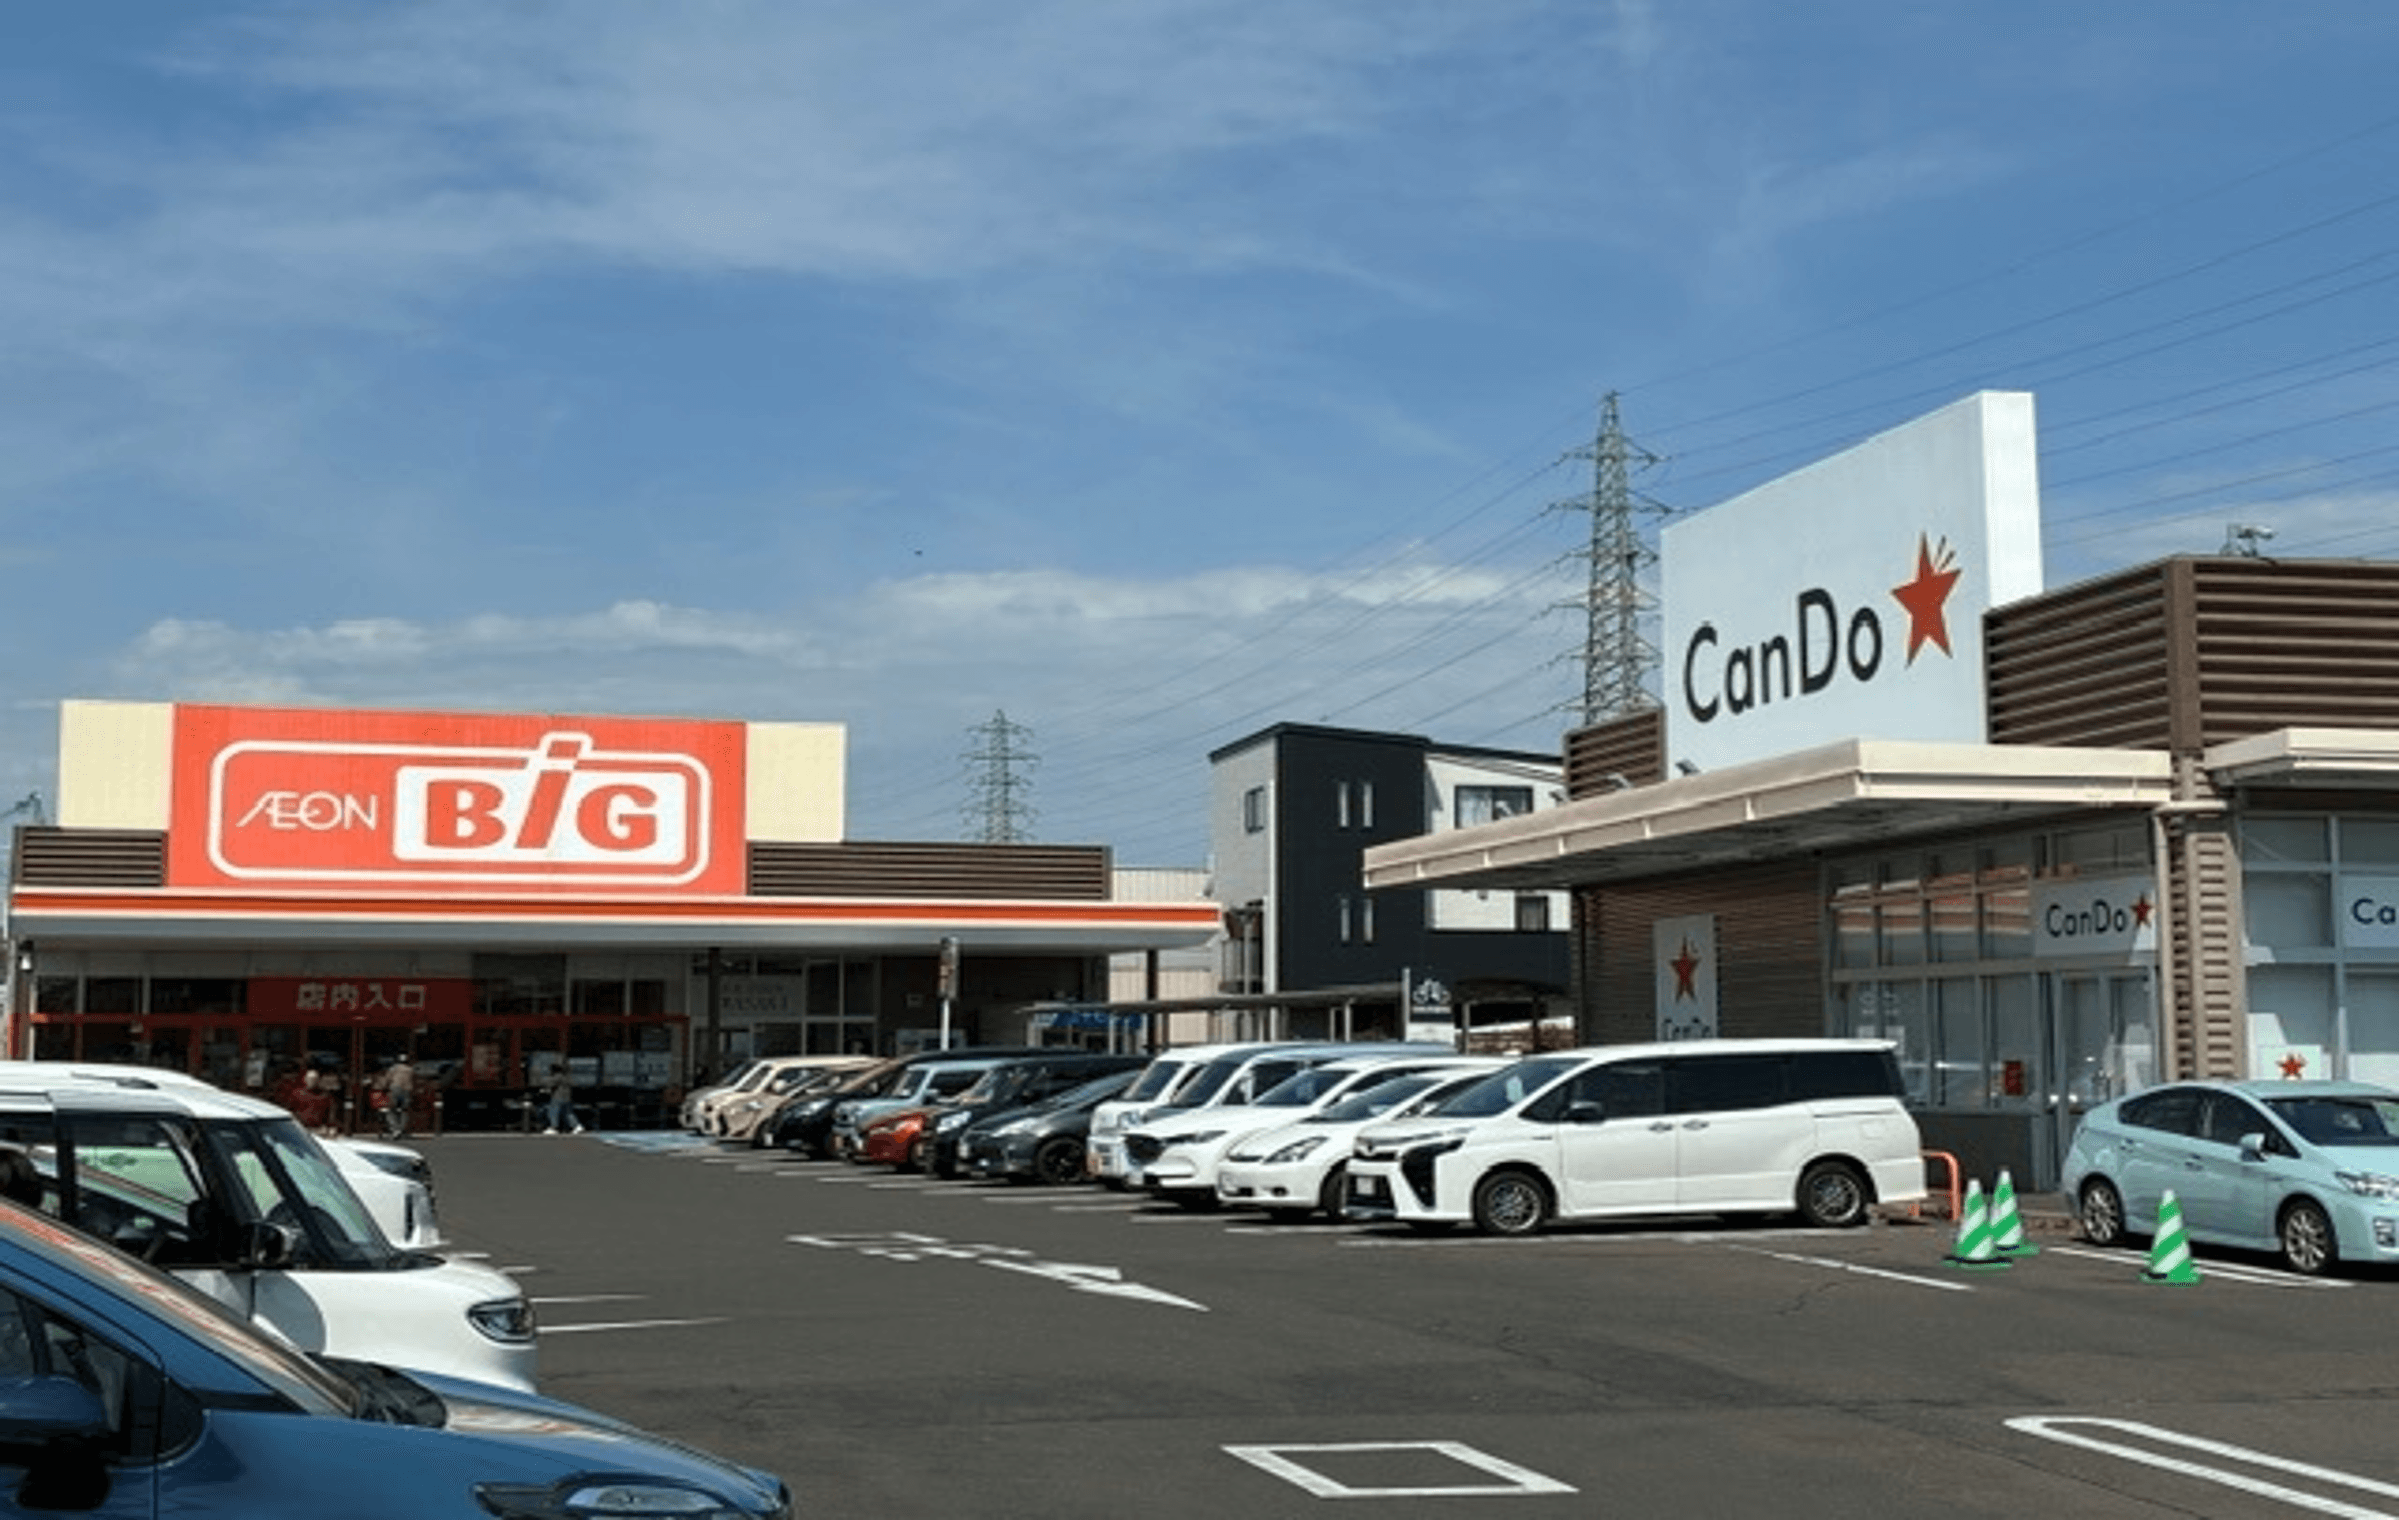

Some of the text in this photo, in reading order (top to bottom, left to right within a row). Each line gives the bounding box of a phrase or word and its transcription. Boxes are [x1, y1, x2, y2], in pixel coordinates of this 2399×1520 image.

[1684, 588, 1882, 723] CanDo
[2046, 899, 2128, 938] CanDo
[296, 982, 427, 1011] 店内入口
